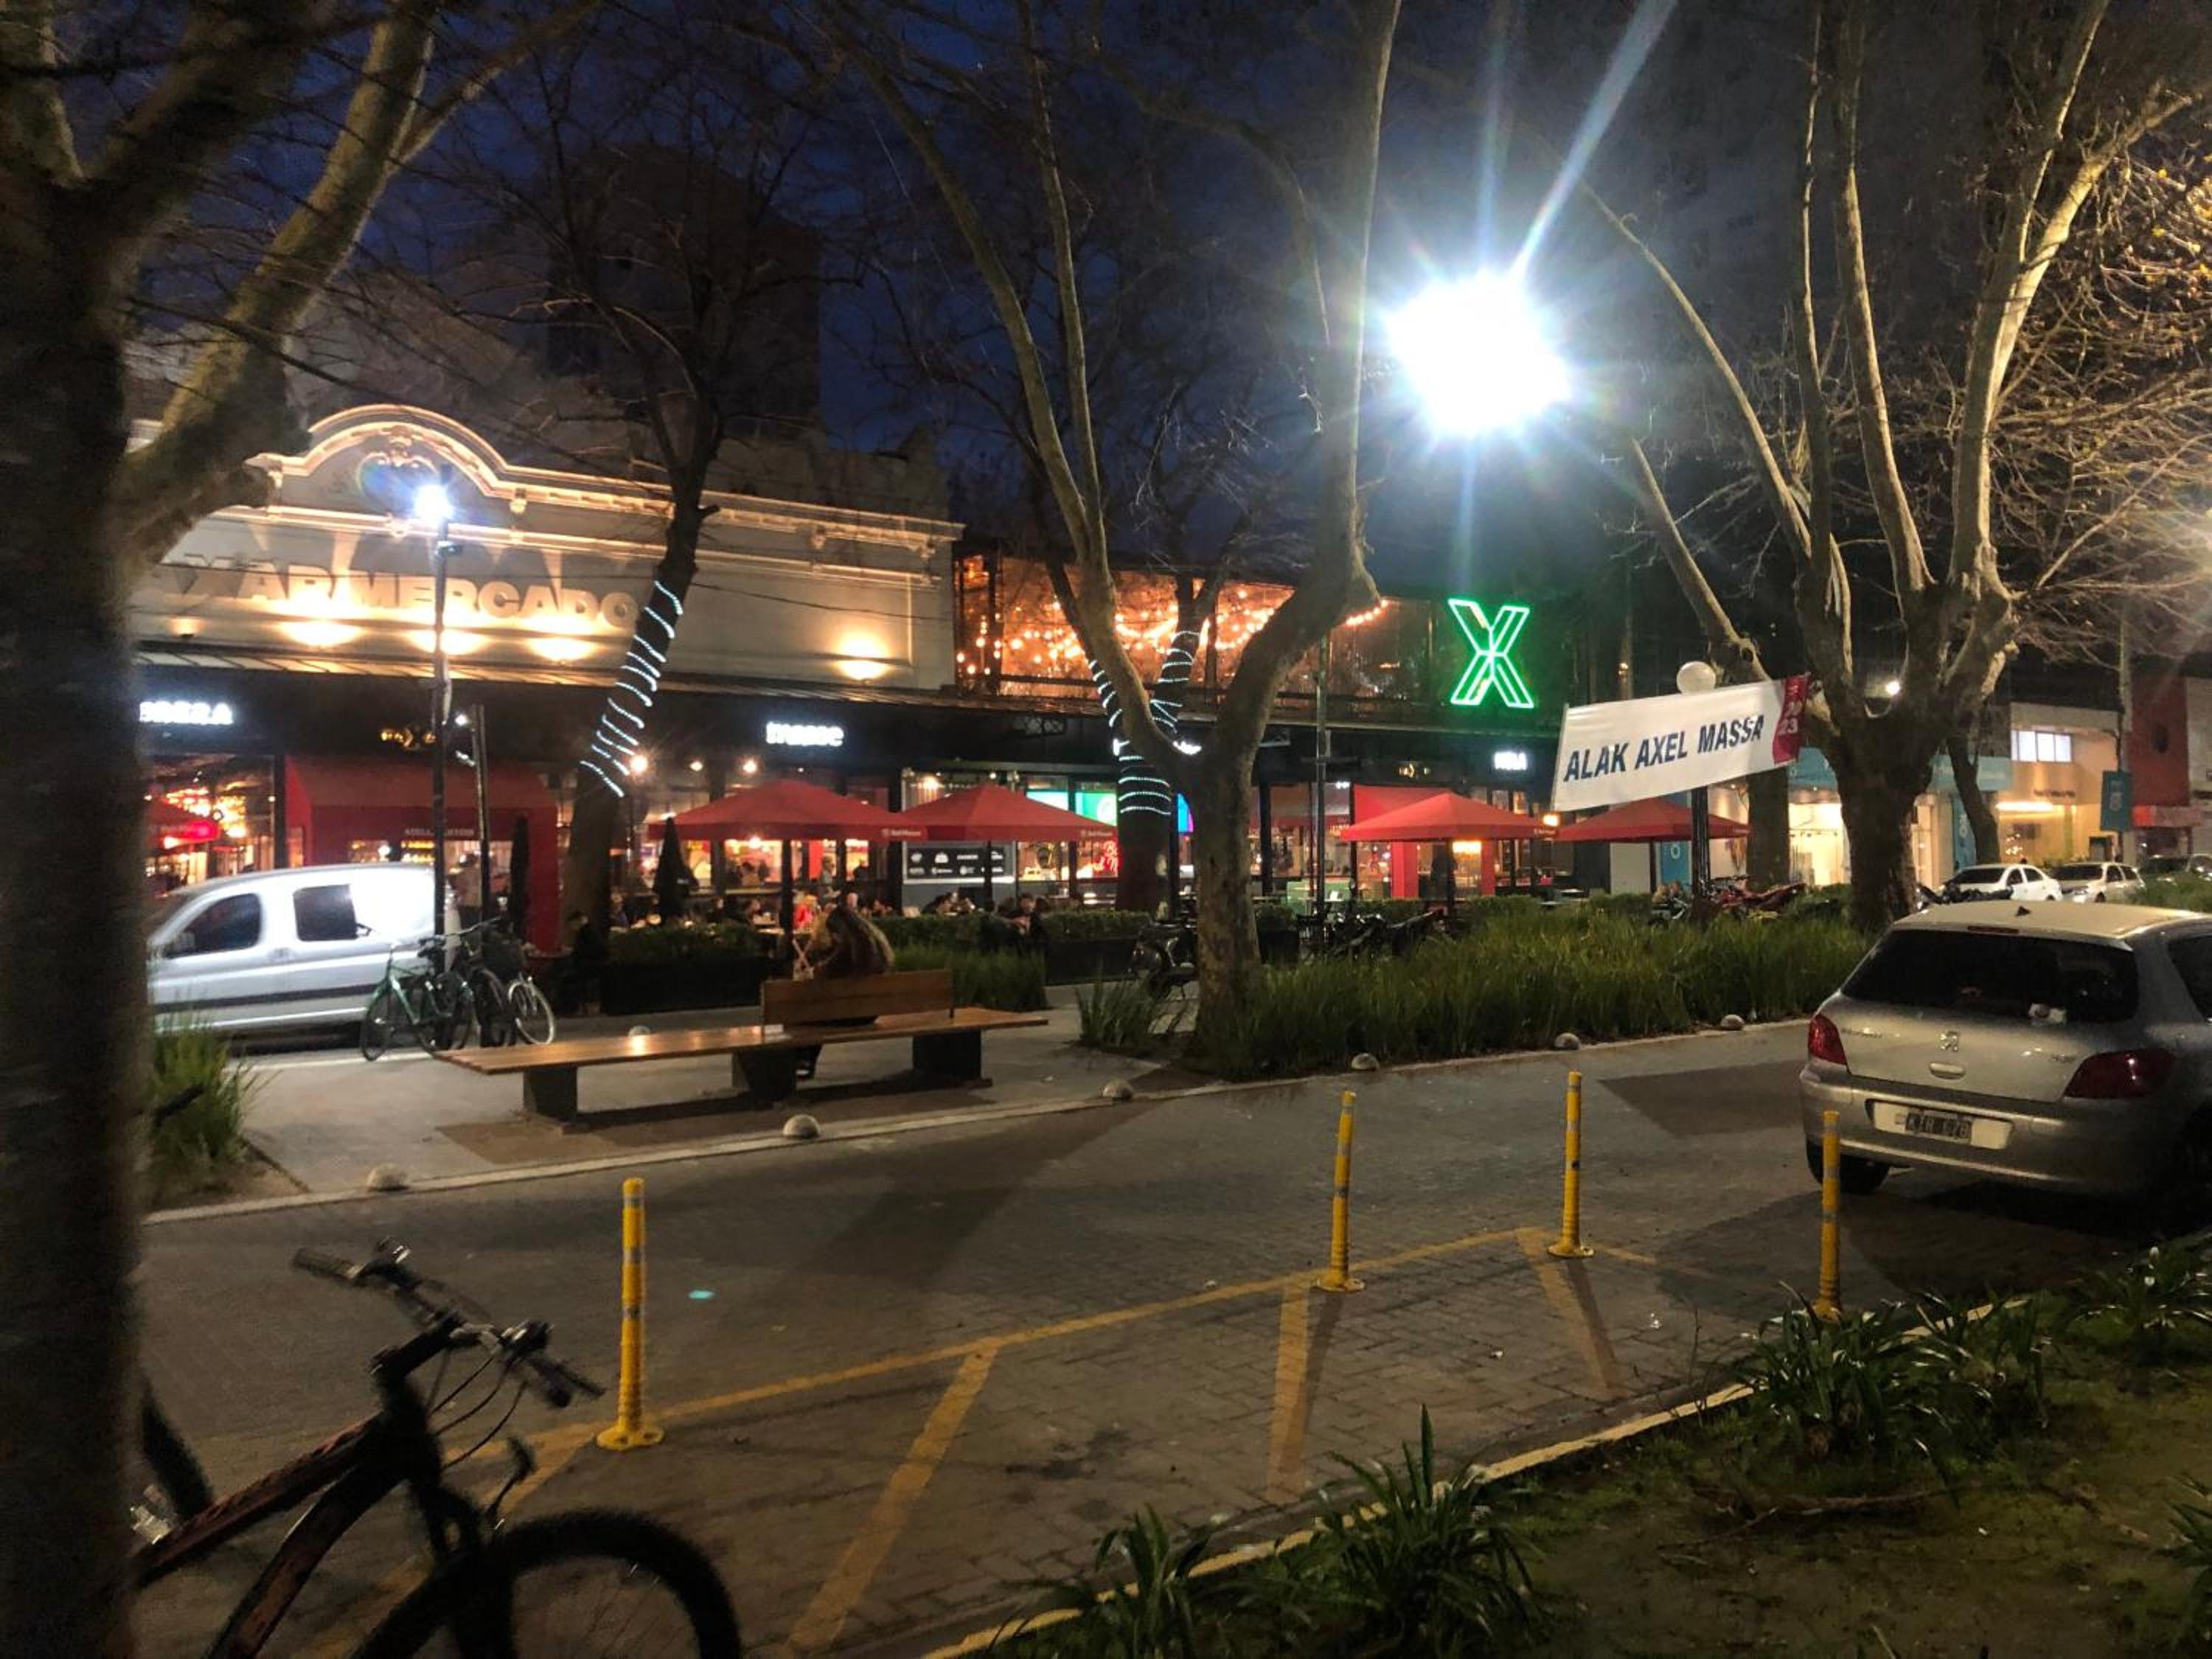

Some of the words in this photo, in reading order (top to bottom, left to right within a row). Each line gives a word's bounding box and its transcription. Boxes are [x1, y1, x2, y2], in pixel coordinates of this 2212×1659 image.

[348, 568, 639, 629] MERCADO
[1448, 599, 1534, 708] X
[1563, 742, 1629, 782] ALAK
[1635, 731, 1688, 770] AXEL
[1697, 714, 1764, 754] MASSA
